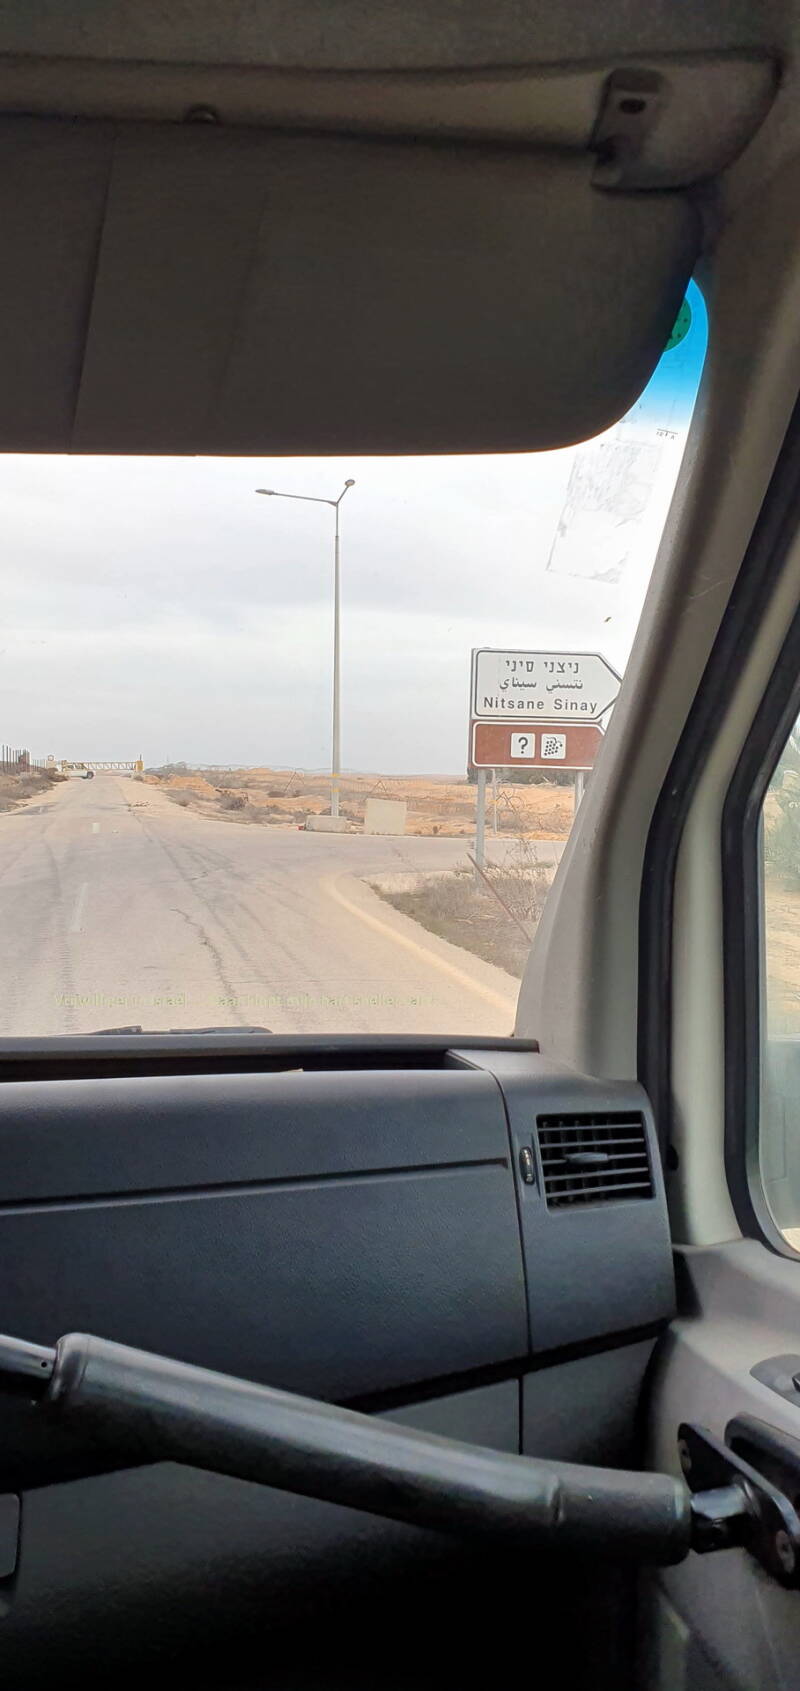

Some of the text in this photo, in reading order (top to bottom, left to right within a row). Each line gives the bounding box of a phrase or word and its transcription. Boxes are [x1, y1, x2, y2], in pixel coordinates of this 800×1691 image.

[505, 659, 580, 674] ניצני סיני
[499, 676, 583, 694] نتسني سيناي
[483, 696, 598, 714] Nitsane Sinay
